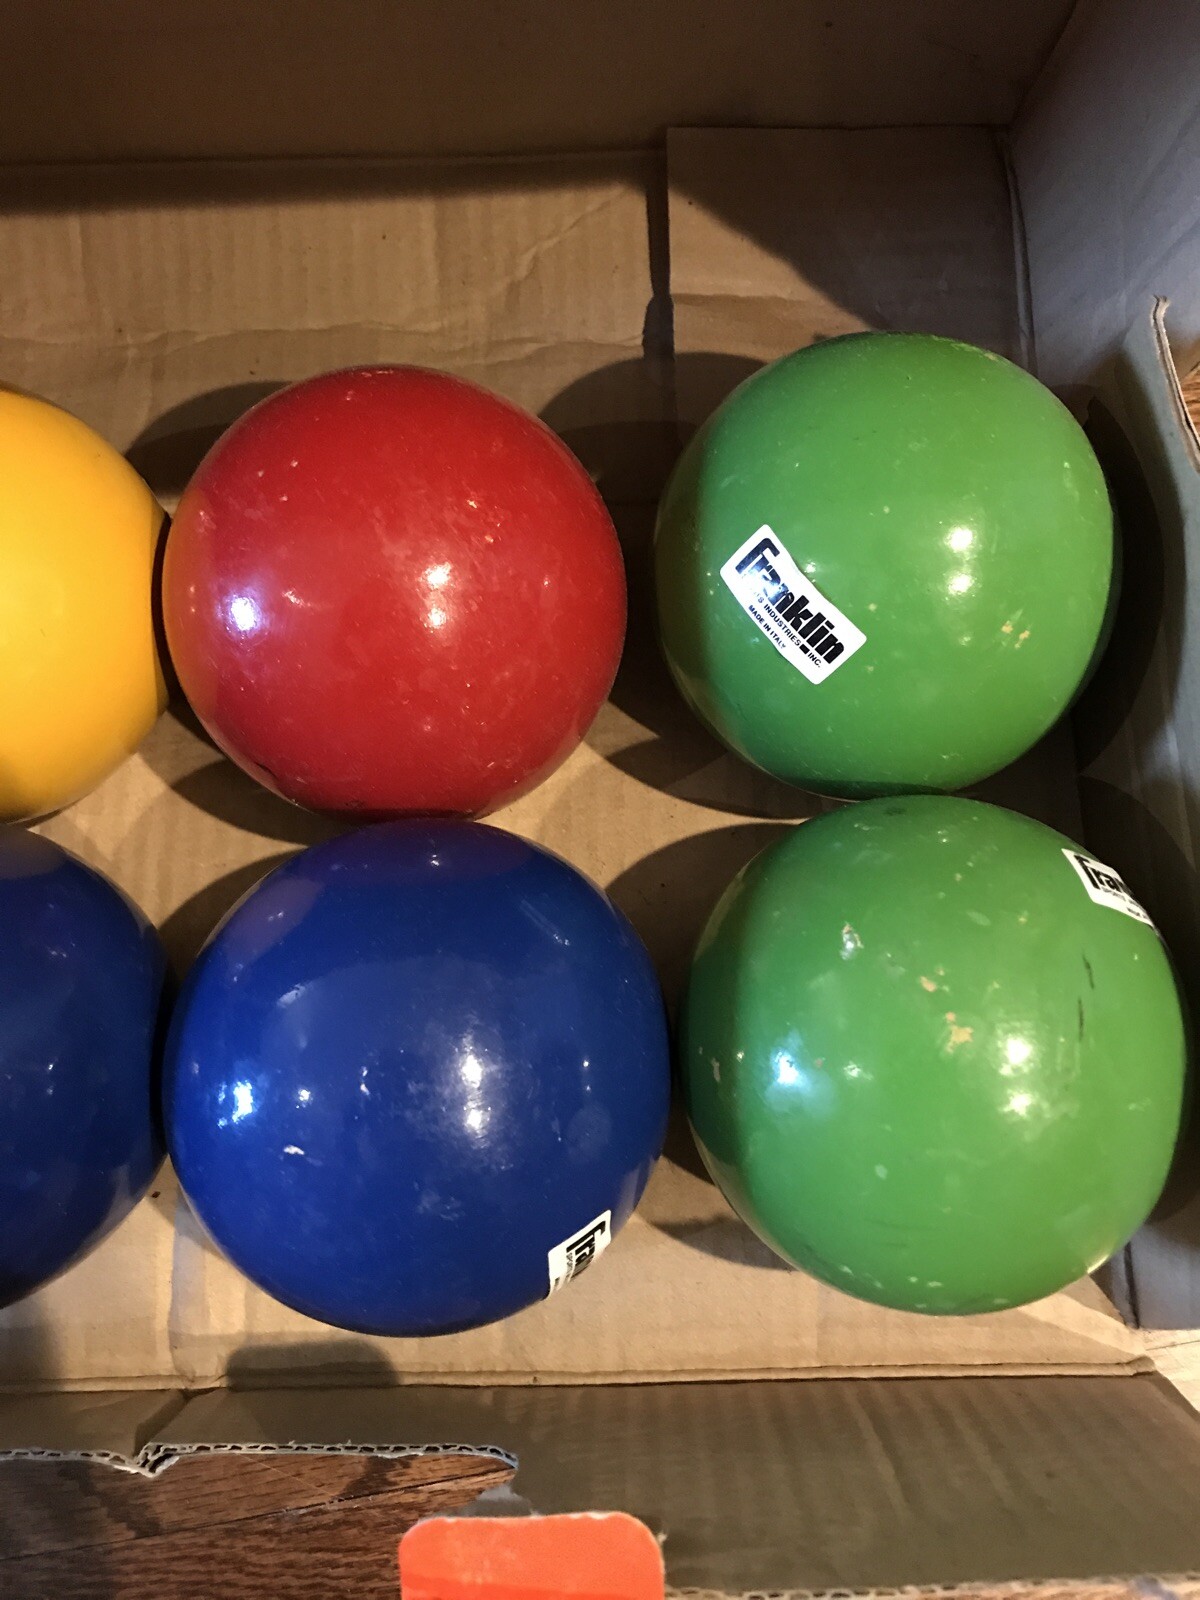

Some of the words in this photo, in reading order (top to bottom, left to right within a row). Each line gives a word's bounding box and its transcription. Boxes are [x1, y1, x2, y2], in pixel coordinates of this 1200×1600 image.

[748, 604, 764, 624] MADE
[764, 623, 772, 632] IN
[770, 630, 786, 649] ITALY
[763, 603, 802, 646] INDUSTRIES
[808, 652, 822, 667] INC.
